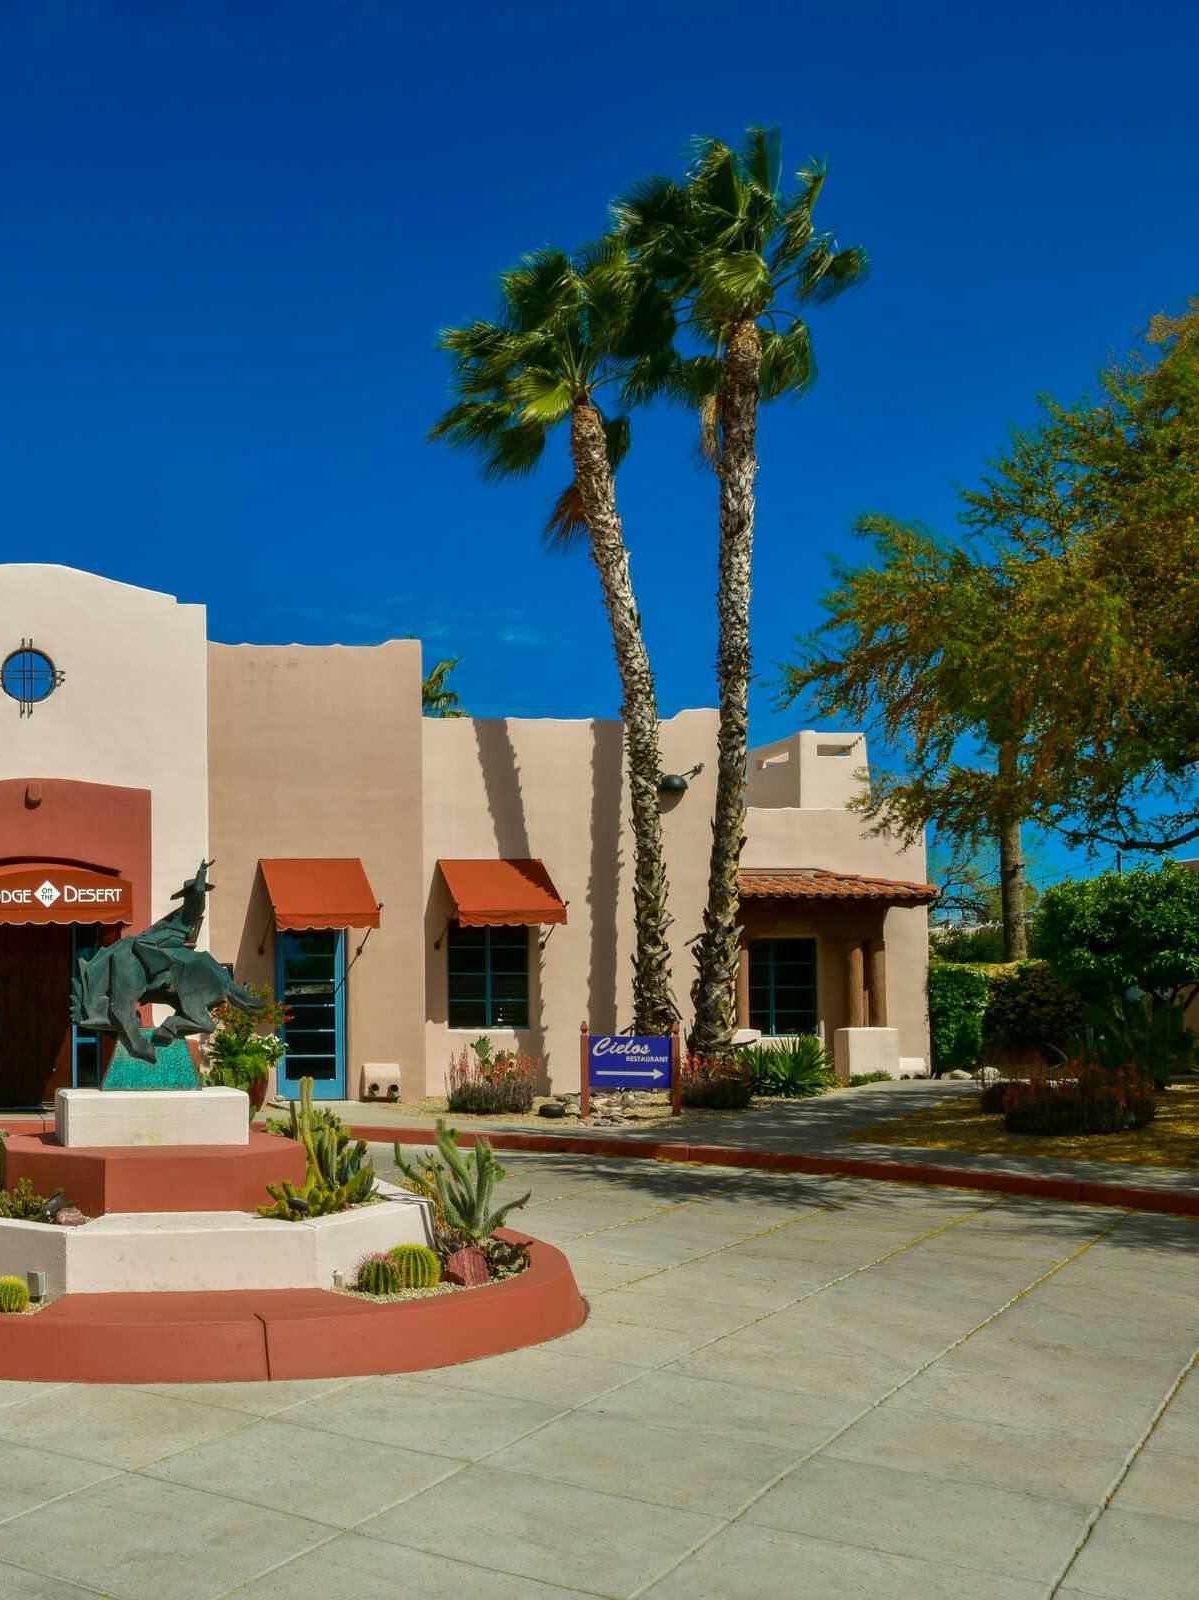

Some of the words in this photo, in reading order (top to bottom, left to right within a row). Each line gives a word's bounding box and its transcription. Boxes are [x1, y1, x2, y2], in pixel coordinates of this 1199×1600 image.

[64, 885, 122, 903] DESERT
[592, 1037, 651, 1057] Cielos
[625, 1055, 669, 1063] RESTAURANT
